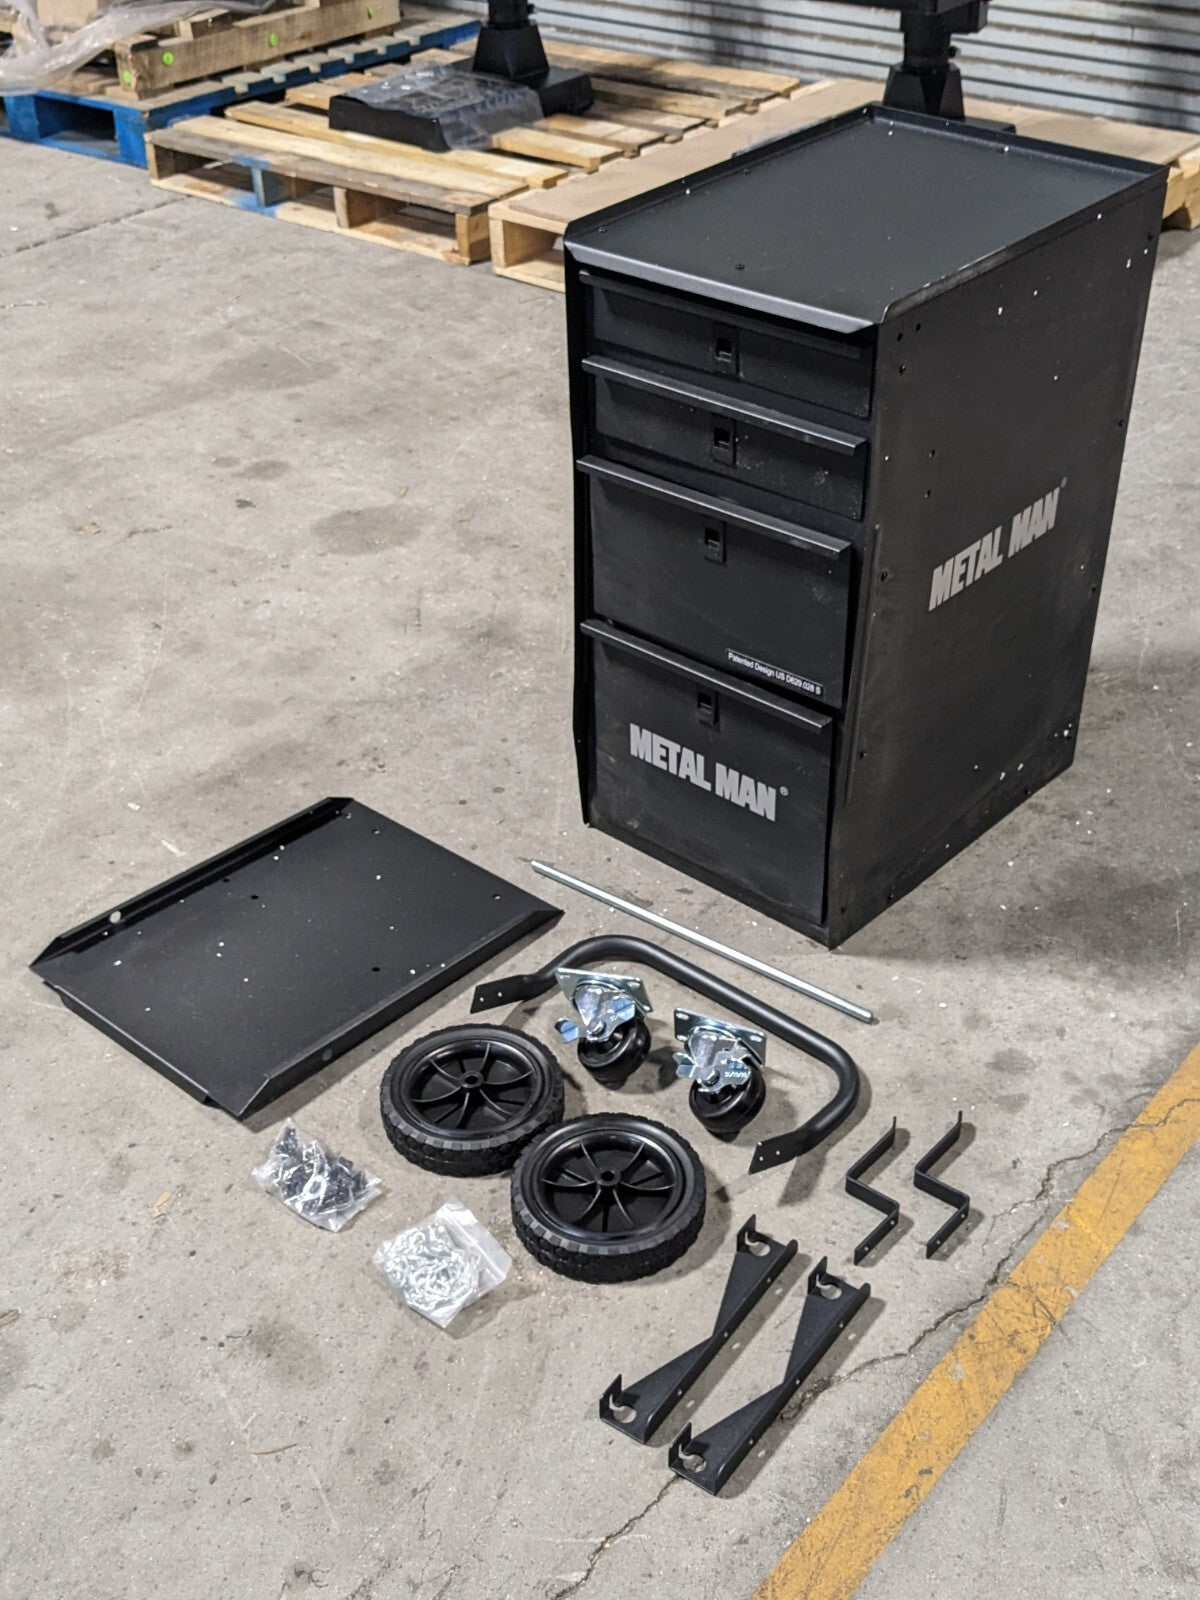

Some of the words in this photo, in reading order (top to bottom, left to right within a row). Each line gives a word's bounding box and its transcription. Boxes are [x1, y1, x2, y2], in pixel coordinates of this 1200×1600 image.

[929, 525, 1003, 612] METAL
[728, 652, 754, 669] Patented
[754, 662, 775, 677] Design
[775, 670, 786, 681] US
[630, 723, 712, 792] METAL
